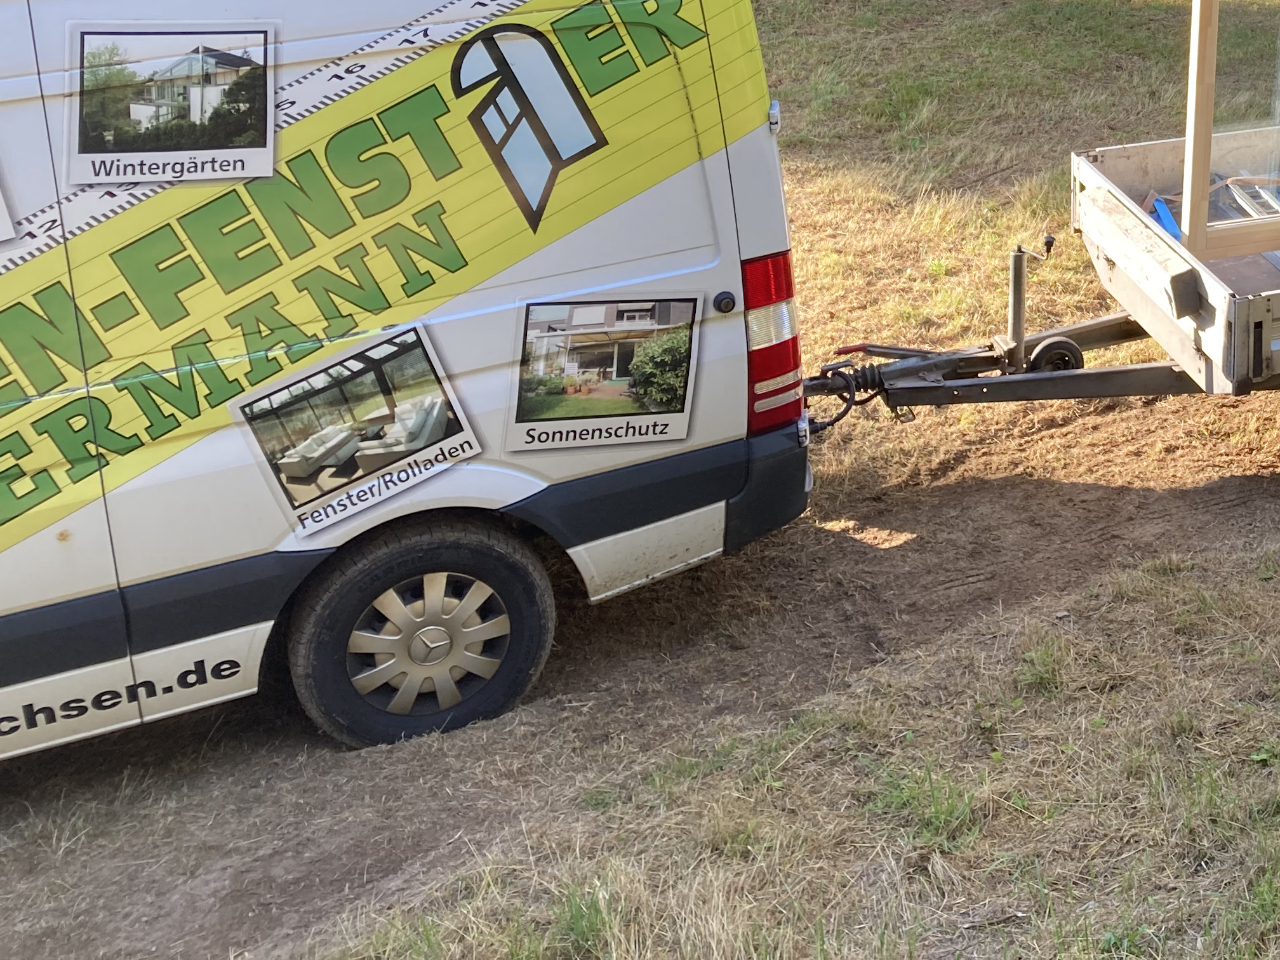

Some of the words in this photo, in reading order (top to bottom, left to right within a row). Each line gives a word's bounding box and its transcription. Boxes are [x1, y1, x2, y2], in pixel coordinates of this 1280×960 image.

[19, 219, 62, 240] 12
[275, 99, 296, 111] 5
[327, 63, 366, 82] 16
[398, 28, 430, 46] 17
[91, 156, 246, 179] Wintergärten
[524, 420, 670, 445] Sonnenschutz
[297, 439, 474, 529] Fenster/Rolladen
